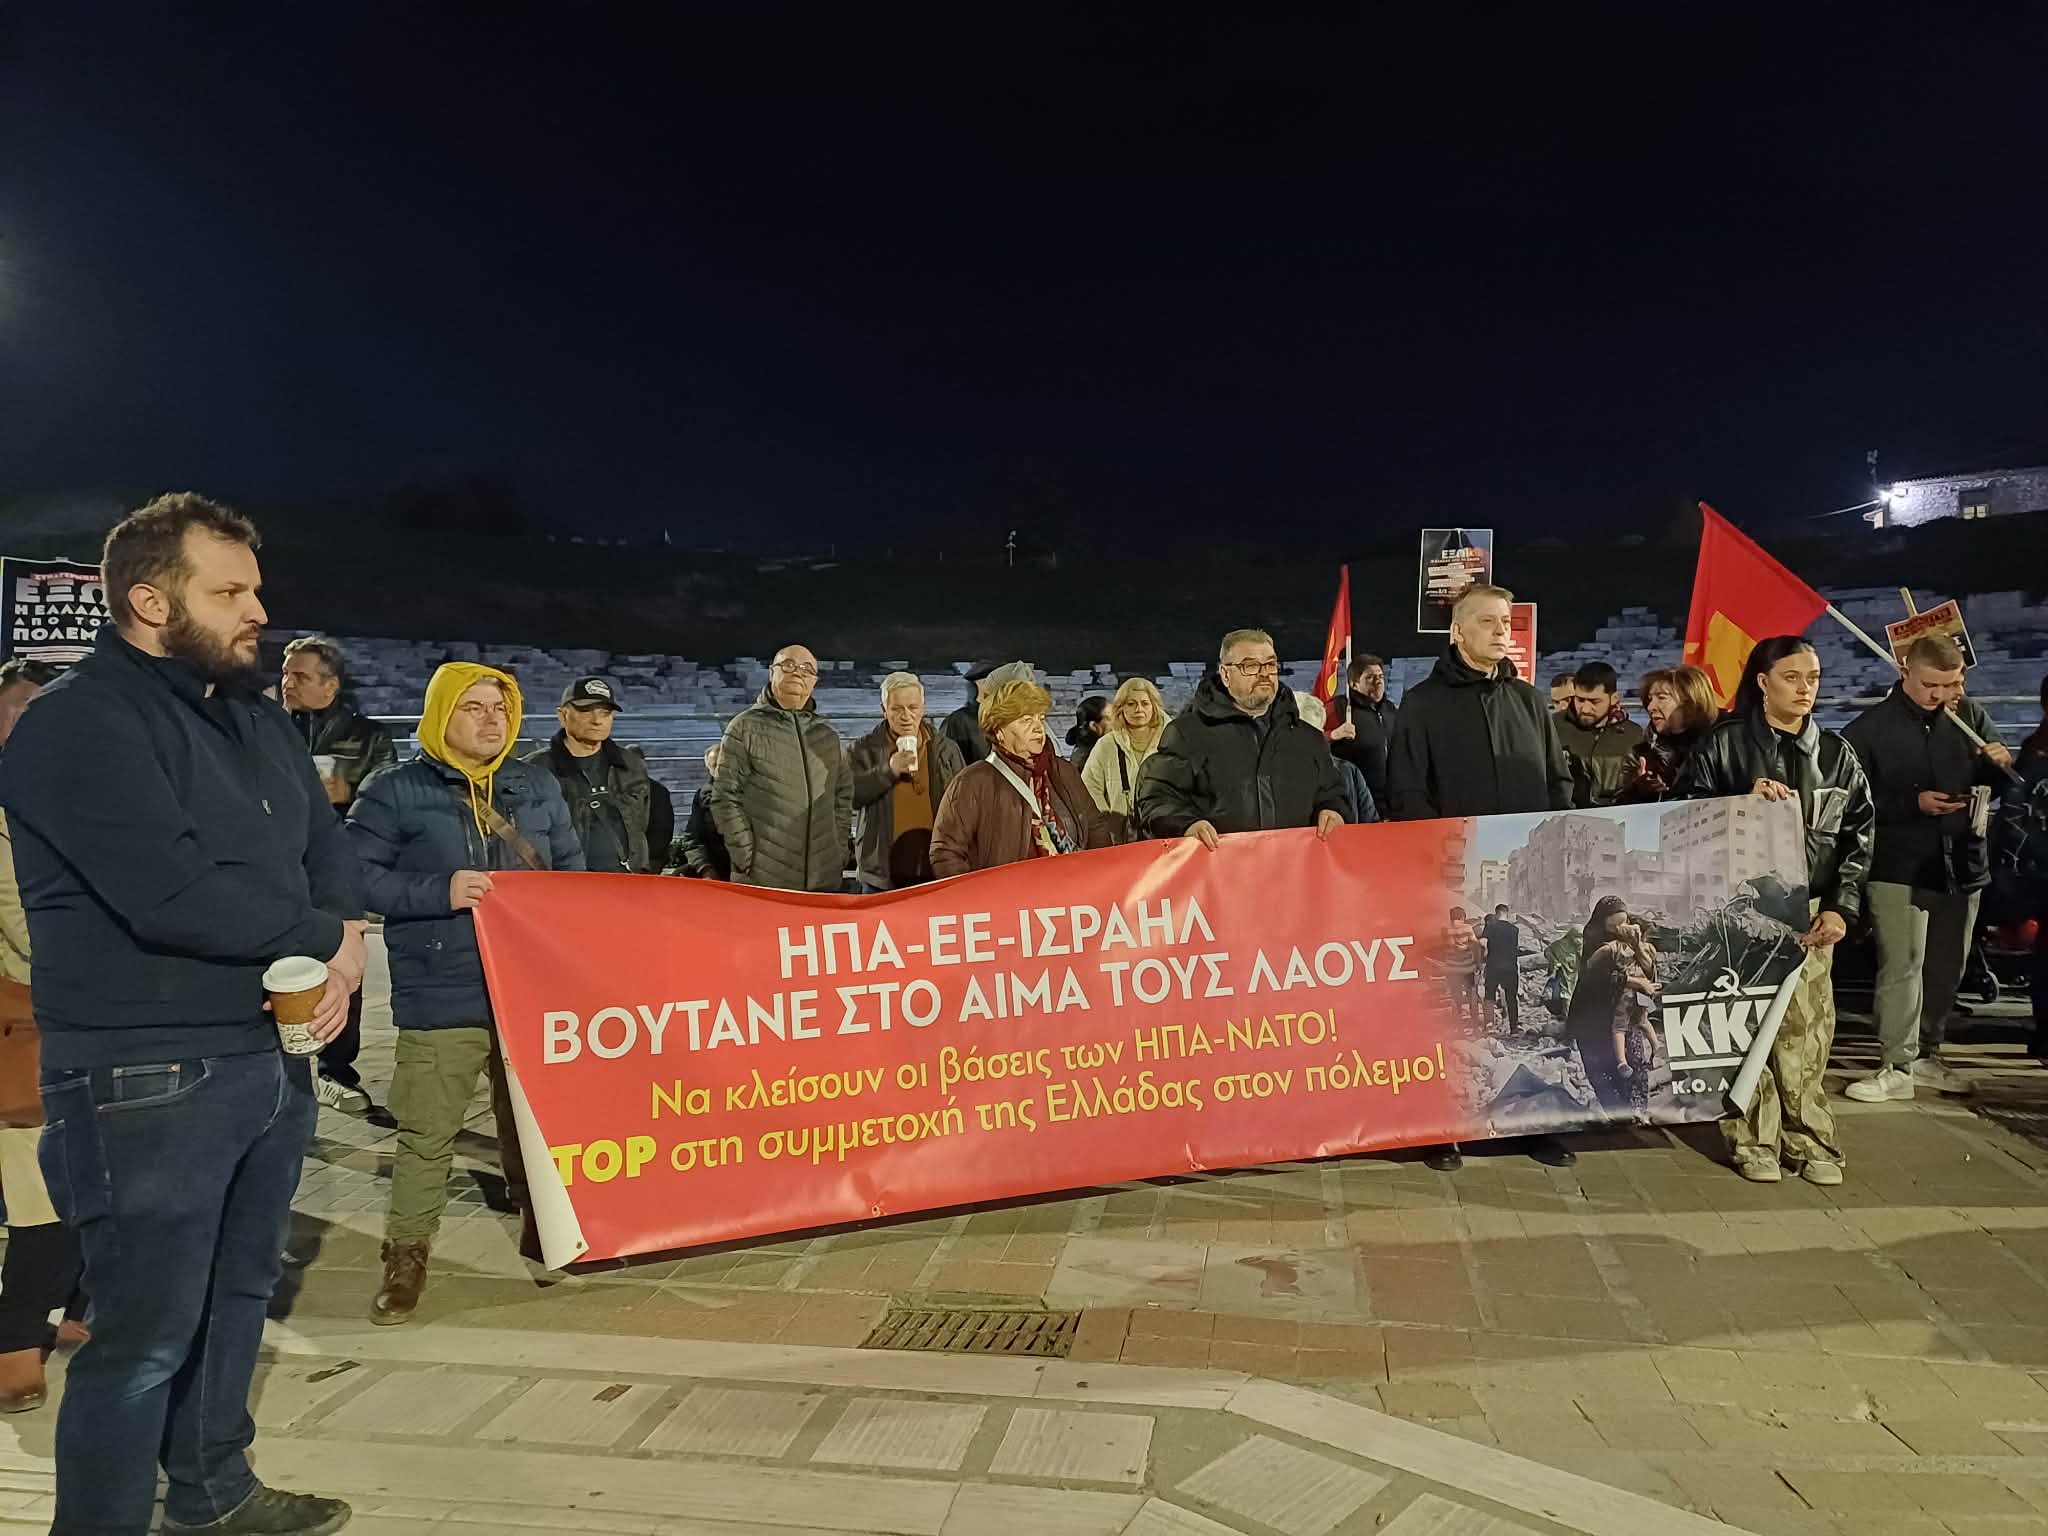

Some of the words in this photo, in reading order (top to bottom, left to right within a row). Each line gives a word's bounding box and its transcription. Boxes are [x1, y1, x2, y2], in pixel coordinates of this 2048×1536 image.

[14, 604, 28, 615] Η
[16, 577, 110, 605] ΕΞΩ
[13, 627, 98, 641] ΠΟΛΕΜ
[14, 616, 59, 626] ΑΠΟ
[75, 616, 111, 627] ΤΟ
[778, 895, 1216, 979] ΗΠΑ-ΕΕ-ΙΣΡΑΗΛ
[543, 989, 821, 1064] ΒΟΥΤΑΝΕ
[835, 979, 942, 1035] ΣΤΟ
[958, 966, 1091, 1023] ΑΙΜΑ
[1099, 952, 1234, 1007] ΤΟΥΣ
[1247, 935, 1419, 993] ΛΑΟΥΣ
[652, 1079, 711, 1119] Να
[726, 1068, 885, 1111] κλείσουν
[896, 1062, 928, 1089] οι
[939, 1044, 1053, 1096] βάσεις
[1060, 1041, 1124, 1070] των
[1135, 1008, 1338, 1062] ΗΠΑ-ΝΑΤΟ!
[549, 1135, 657, 1186] TOP
[670, 1135, 743, 1171] στη
[757, 1105, 964, 1165] συμμετοχή
[975, 1097, 1037, 1133] της
[1046, 1066, 1204, 1122] Ελλάδας
[1212, 1068, 1294, 1102] στον
[1305, 1042, 1448, 1095] πόλεμο!
